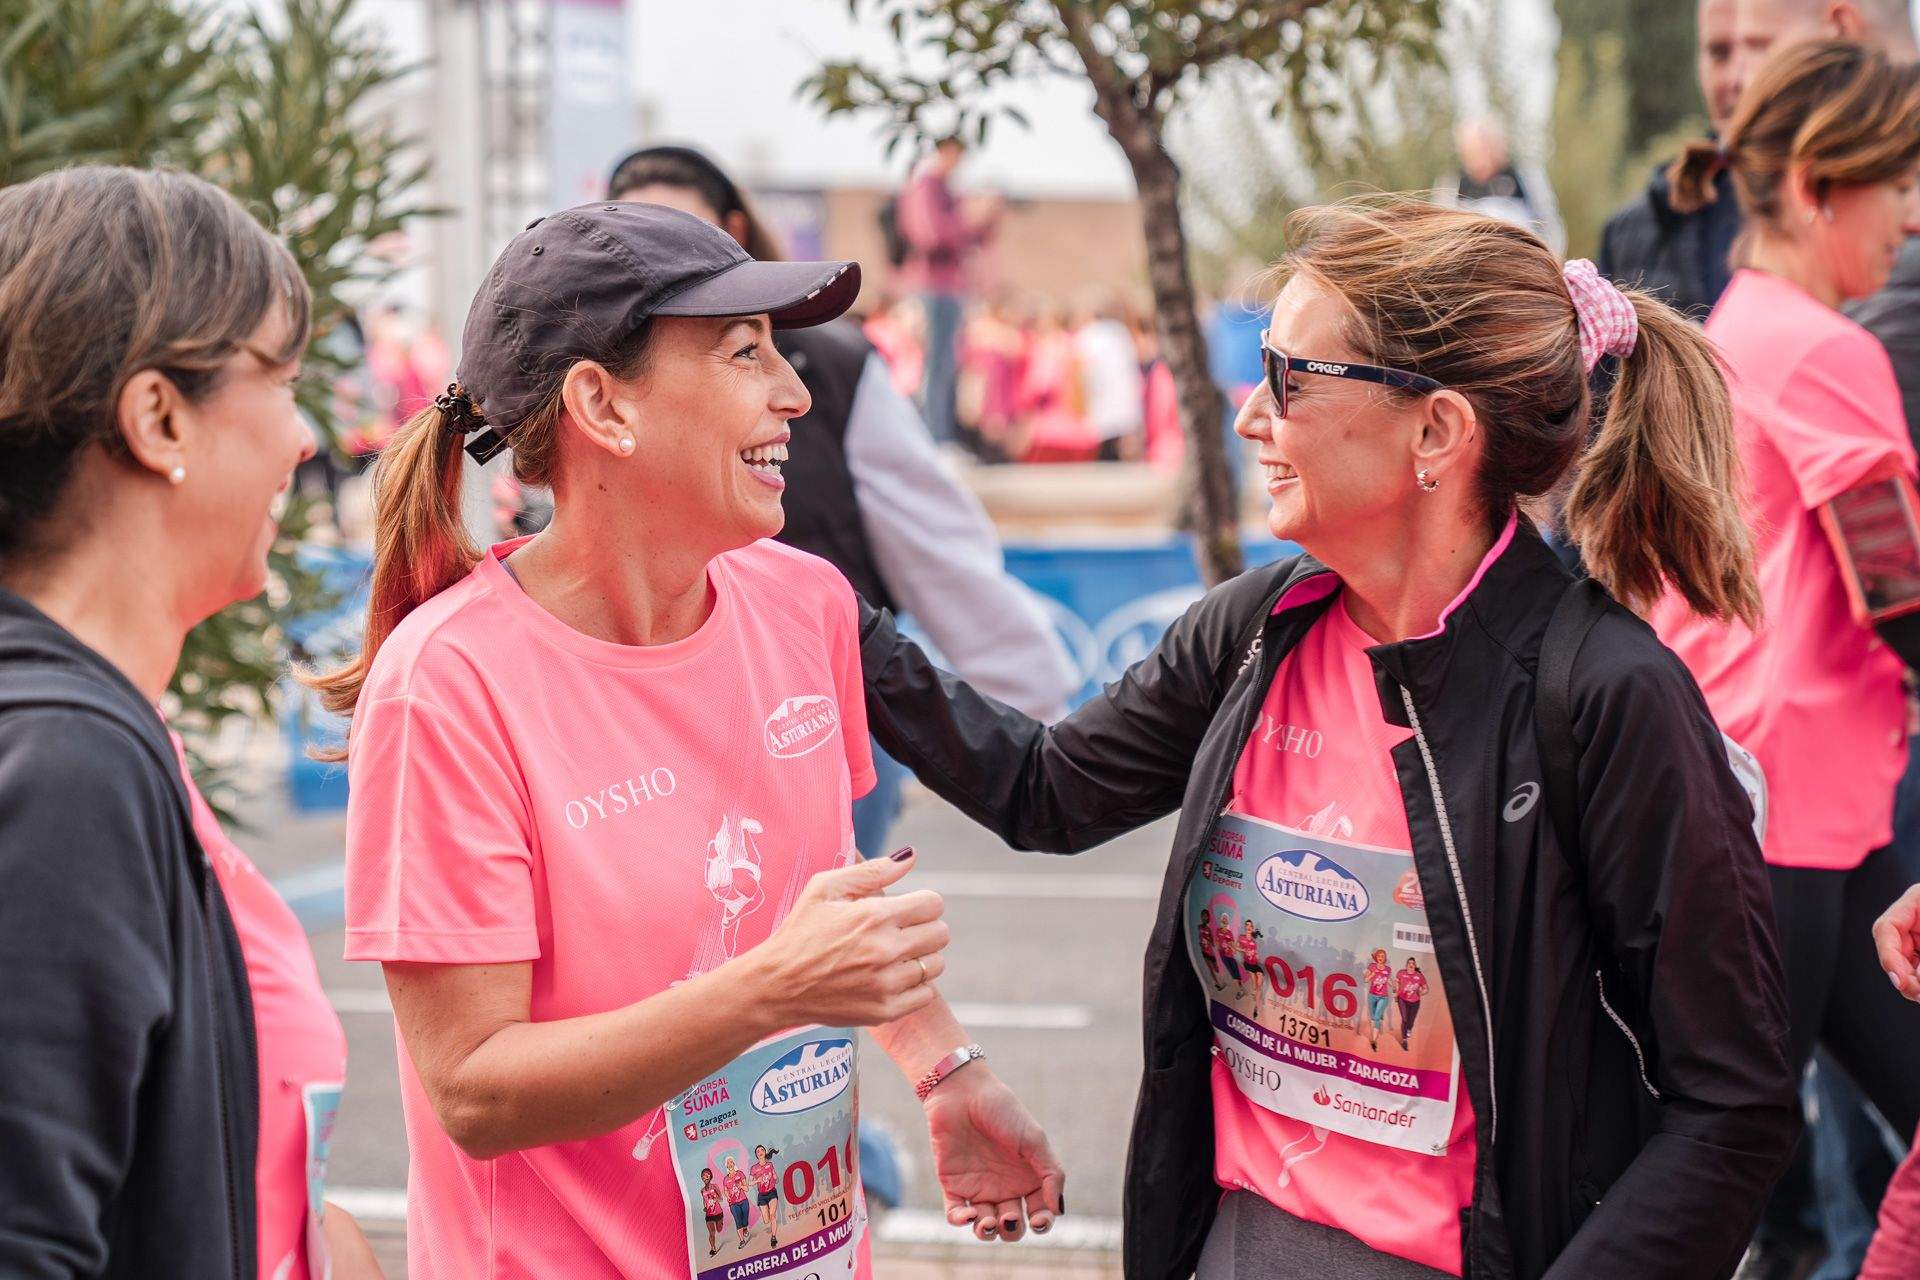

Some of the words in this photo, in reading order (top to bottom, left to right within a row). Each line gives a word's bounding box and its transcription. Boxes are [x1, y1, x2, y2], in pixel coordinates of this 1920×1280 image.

[1307, 361, 1348, 375] OAKLEY
[768, 709, 838, 753] ASTURIANA
[565, 767, 676, 829] OYSHO
[1210, 837, 1243, 860] SUMA
[1214, 863, 1243, 879] Zaragoza
[1261, 866, 1359, 912] ASTURIANA
[1265, 956, 1357, 1018] 016
[1280, 1014, 1330, 1047] 13791
[1226, 1014, 1260, 1044] CARRERA
[1262, 1034, 1275, 1051] DE
[1277, 1041, 1291, 1057] LA
[1294, 1047, 1337, 1069] MUJER
[1348, 1059, 1419, 1089] ZARAGOZA
[777, 1064, 815, 1082] CENTRAL
[1225, 1047, 1281, 1091] OYSHO
[684, 1087, 730, 1116] SUMA
[1333, 1093, 1416, 1128] Santander
[699, 1109, 737, 1128] Zaragoza
[701, 1119, 739, 1137] DEPORTE
[818, 1198, 847, 1226] 101
[728, 1252, 789, 1280] CARRERA
[792, 1243, 809, 1261] DE
[811, 1236, 826, 1253] LA
